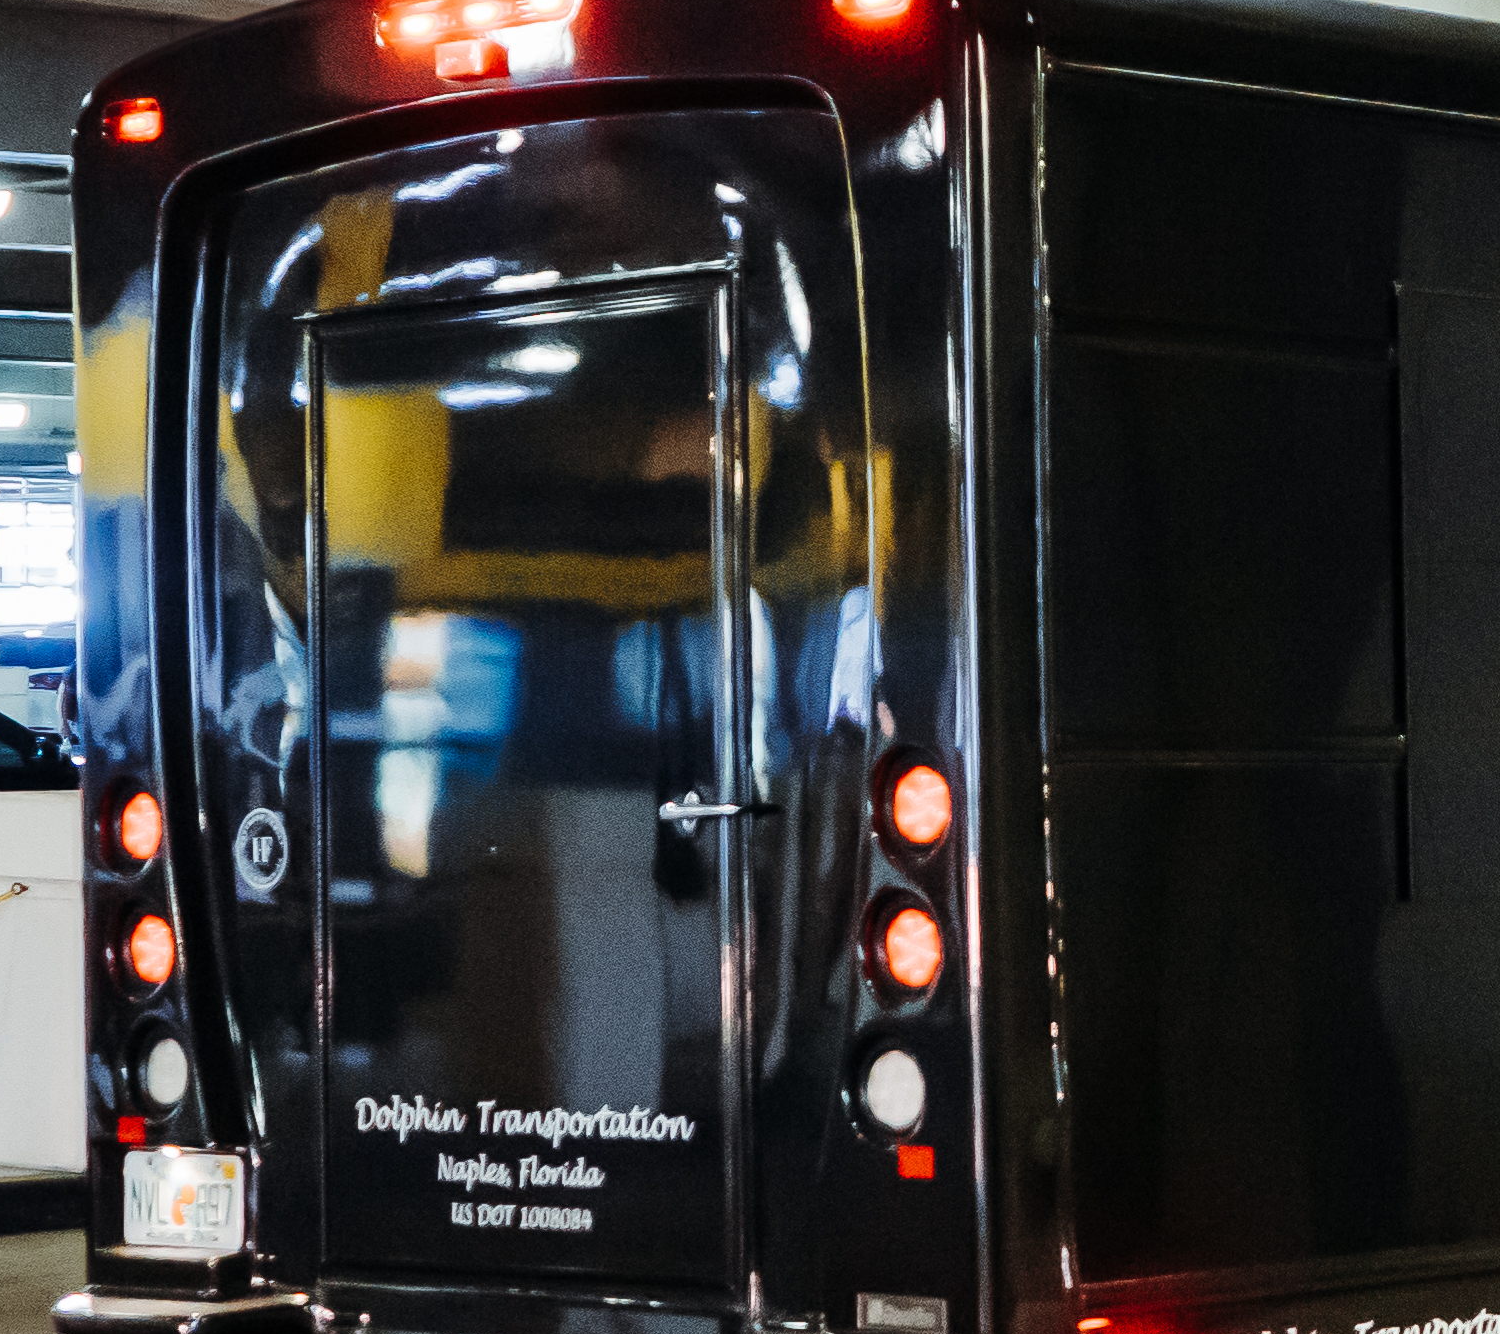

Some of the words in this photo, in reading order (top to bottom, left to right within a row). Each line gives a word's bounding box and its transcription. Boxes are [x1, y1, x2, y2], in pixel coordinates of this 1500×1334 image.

[355, 1095, 467, 1144] Dolphin
[477, 1099, 695, 1149] Transportation
[437, 1153, 513, 1192] Naples,
[518, 1154, 606, 1190] Florida
[451, 1201, 474, 1227] US
[477, 1203, 516, 1228] DOT
[520, 1206, 594, 1232] 1008084
